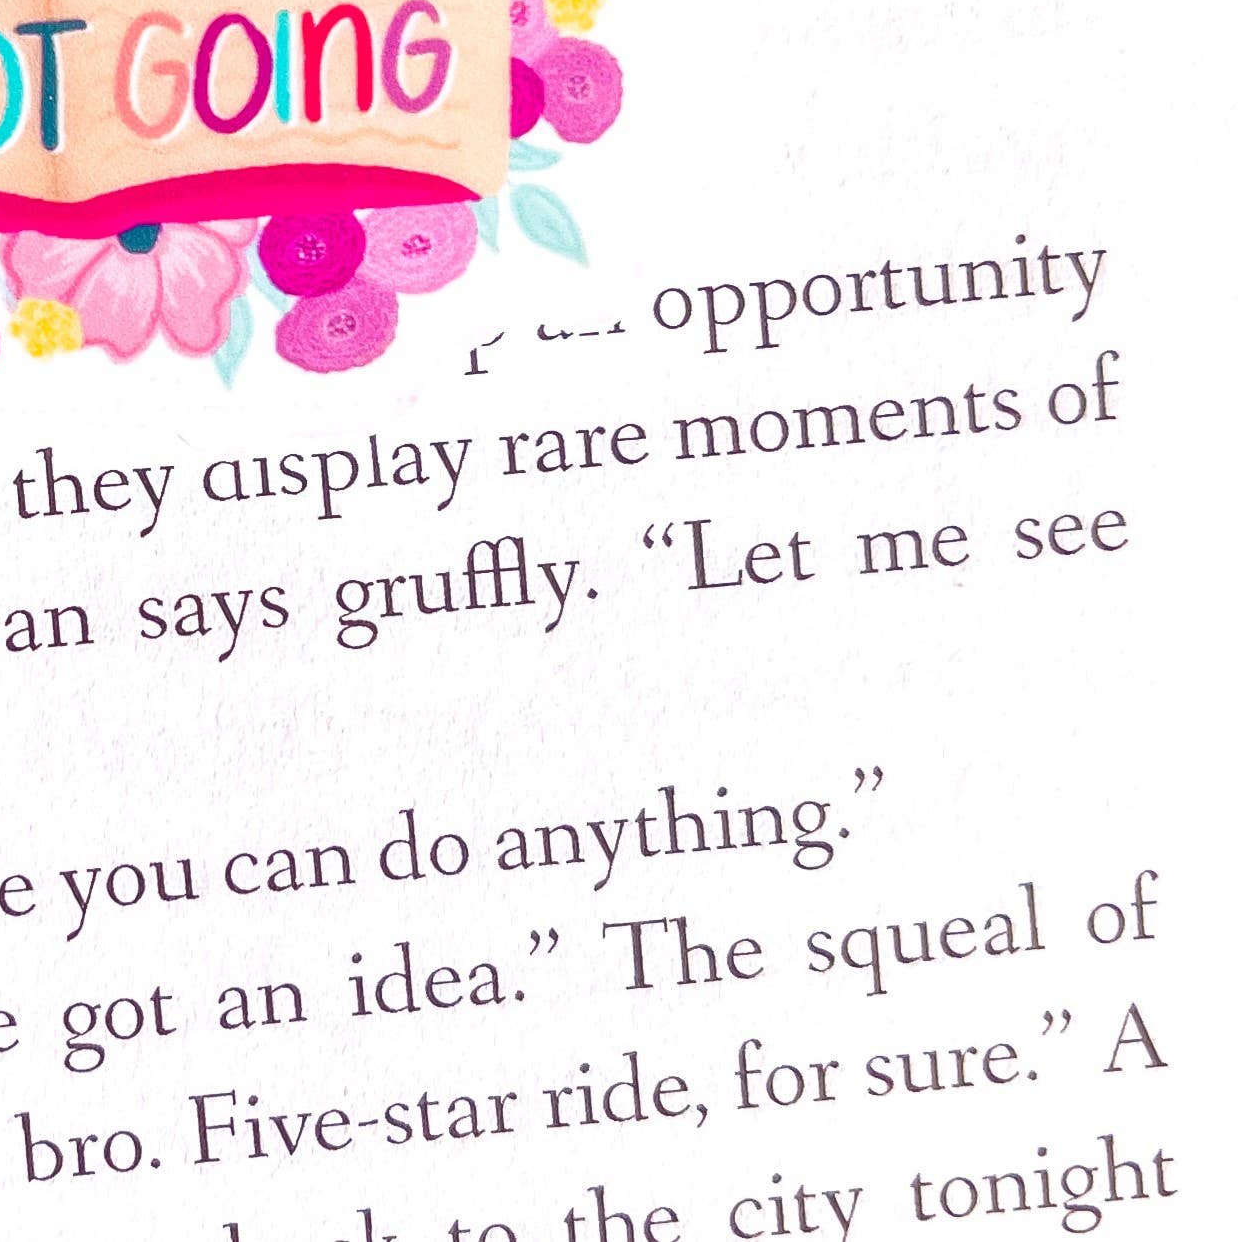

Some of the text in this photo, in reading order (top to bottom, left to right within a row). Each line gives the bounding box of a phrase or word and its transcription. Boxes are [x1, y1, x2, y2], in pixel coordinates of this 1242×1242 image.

[654, 235, 1106, 354] opportunity
[13, 447, 174, 537] they
[203, 435, 472, 519] display
[499, 424, 648, 475] rare
[673, 384, 1021, 459] moments
[1049, 350, 1119, 424] of
[139, 587, 288, 662] says
[336, 536, 598, 649] gruffly.
[644, 519, 815, 589] “Let
[857, 526, 969, 574] me
[1016, 511, 1128, 559] see
[60, 859, 199, 941] you
[225, 846, 355, 894] can
[380, 809, 469, 880] do
[497, 766, 883, 891] anything.”
[64, 987, 176, 1072] got
[219, 984, 307, 1029] an
[349, 928, 558, 1016] idea.”
[603, 917, 763, 989] The
[808, 882, 1045, 996] squeal
[1089, 870, 1157, 943] of
[14, 1112, 160, 1182] bro.
[189, 1090, 517, 1164] Five-star
[543, 1051, 707, 1128] ride,
[735, 1039, 839, 1109] for
[867, 1010, 1071, 1095] sure.”
[1104, 1003, 1168, 1072] A
[564, 1134, 1177, 1242] the city tonight
